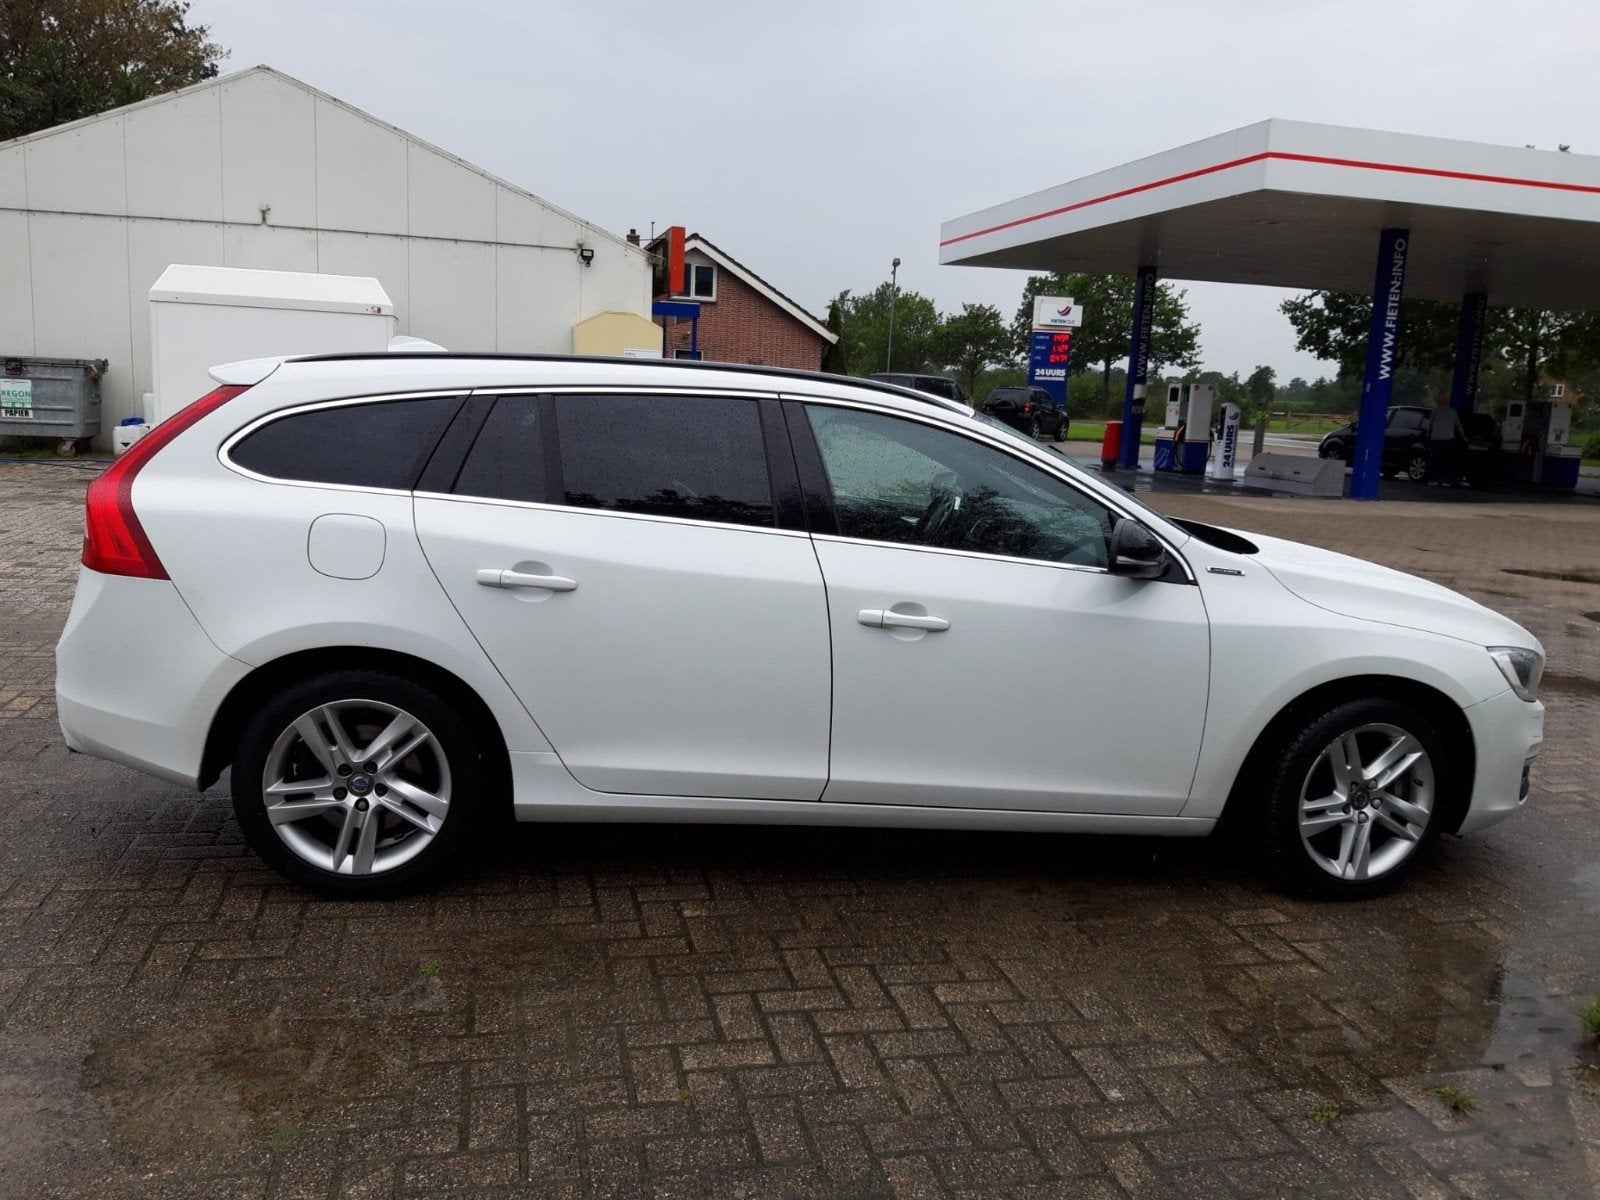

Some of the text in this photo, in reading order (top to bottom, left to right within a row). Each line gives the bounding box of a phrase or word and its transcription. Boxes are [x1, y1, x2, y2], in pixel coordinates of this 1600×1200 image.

[1136, 273, 1155, 378] WWW.FIETEN.INFO
[1034, 368, 1066, 376] 24 UURS
[4, 409, 30, 417] PAPIER
[1224, 424, 1235, 455] UURS
[1223, 455, 1231, 468] 24
